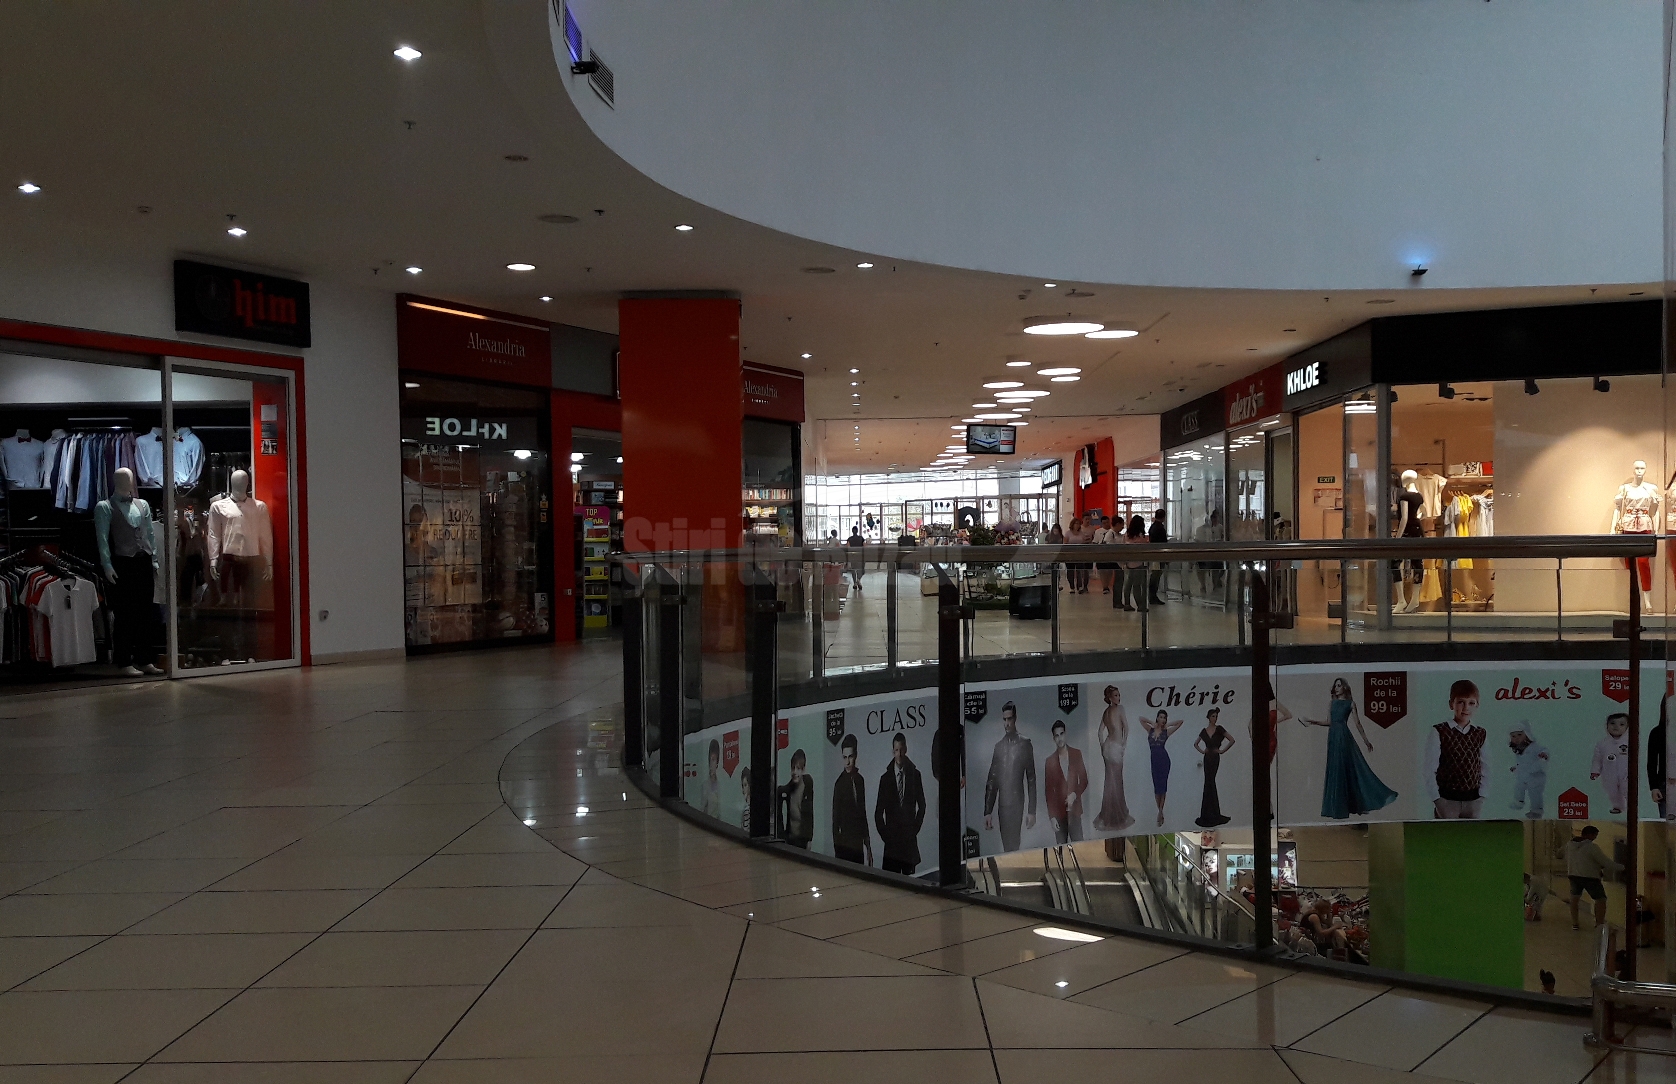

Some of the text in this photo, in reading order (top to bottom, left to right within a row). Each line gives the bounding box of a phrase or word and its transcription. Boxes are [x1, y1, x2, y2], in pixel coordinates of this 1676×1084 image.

[467, 332, 525, 357] Alexandria
[1286, 361, 1321, 396] KHLOE
[586, 508, 598, 516] TOP
[1370, 677, 1401, 686] Rochii
[1609, 682, 1622, 690] 29
[1374, 688, 1397, 697] de la
[1495, 677, 1582, 700] alexi's
[1146, 684, 1235, 708] Chérie
[1370, 701, 1401, 713] 99 lei
[866, 704, 926, 735] CLASS
[1563, 808, 1574, 816] 29
